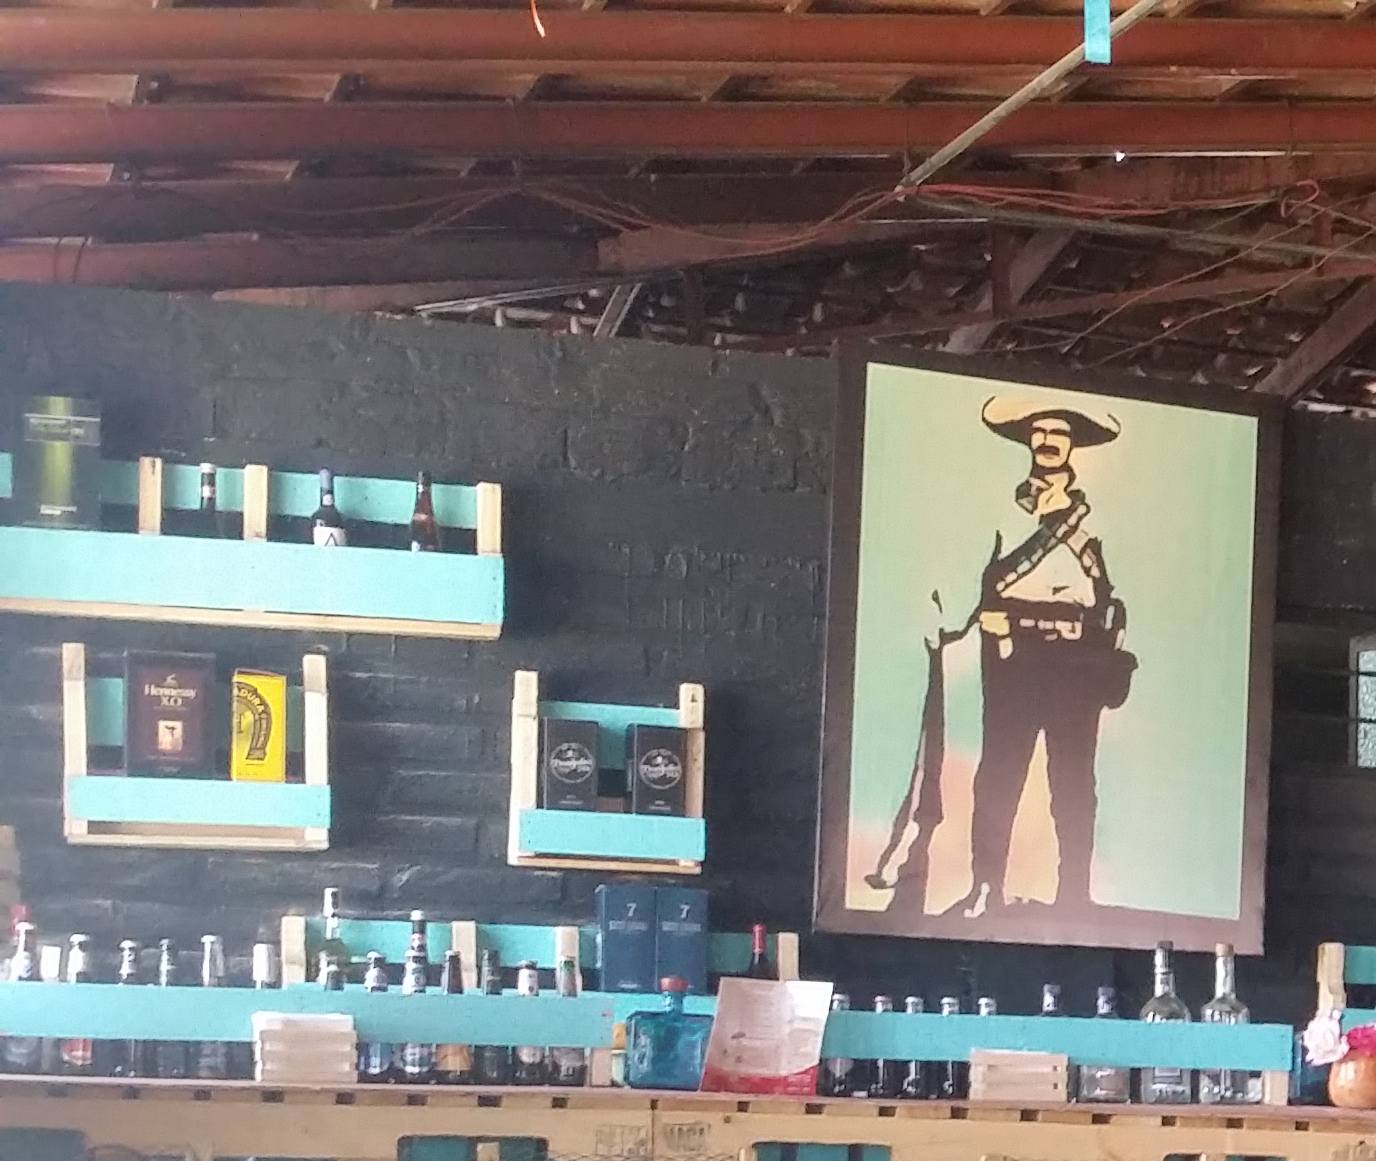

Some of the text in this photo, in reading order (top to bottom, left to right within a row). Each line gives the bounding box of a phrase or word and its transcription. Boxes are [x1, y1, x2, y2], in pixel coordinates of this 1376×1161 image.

[143, 684, 197, 699] Hennessy
[160, 696, 183, 707] XO
[626, 903, 637, 917] 7
[680, 904, 691, 919] 7
